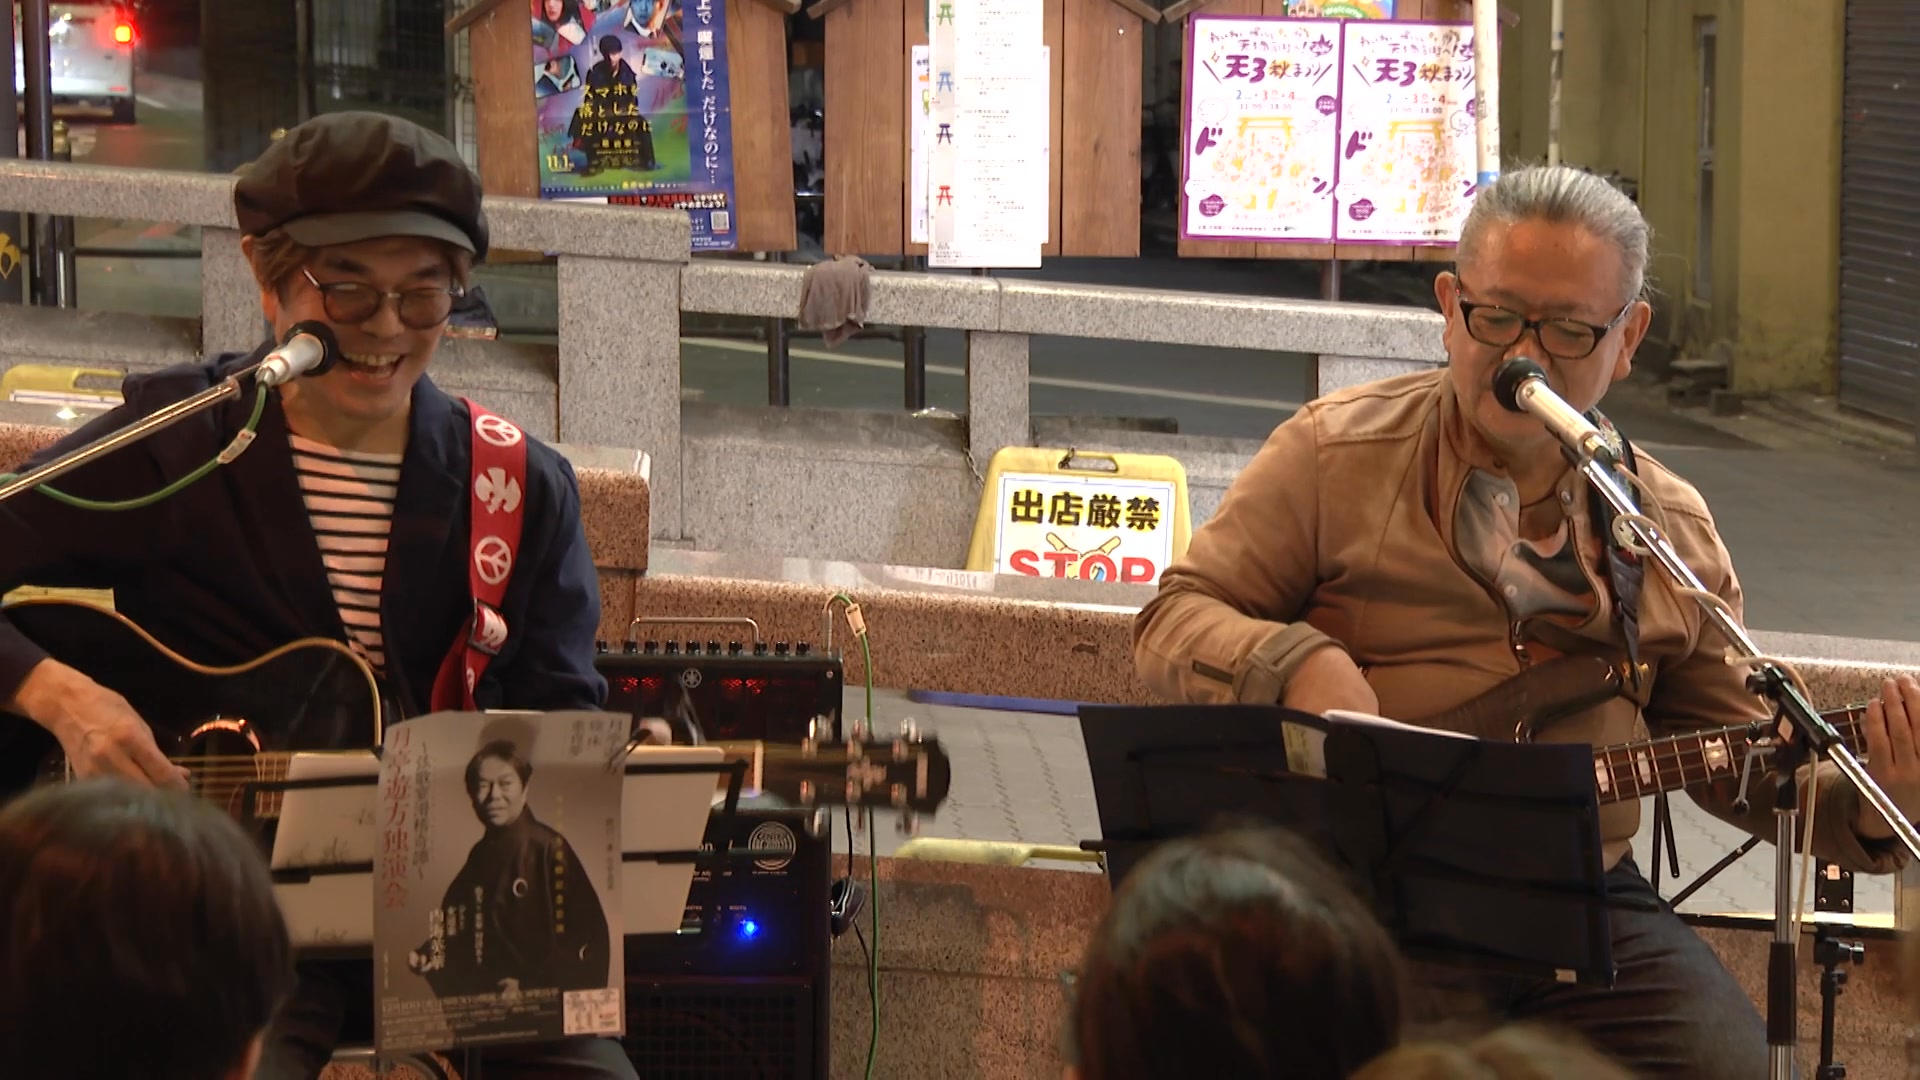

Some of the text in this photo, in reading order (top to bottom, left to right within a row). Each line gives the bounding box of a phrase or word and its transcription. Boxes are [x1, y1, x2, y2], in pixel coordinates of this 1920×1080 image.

[579, 102, 639, 119] 落とした
[581, 120, 653, 136] だけなのに
[1011, 489, 1160, 531] 出店厳禁
[1010, 549, 1156, 584] STOP
